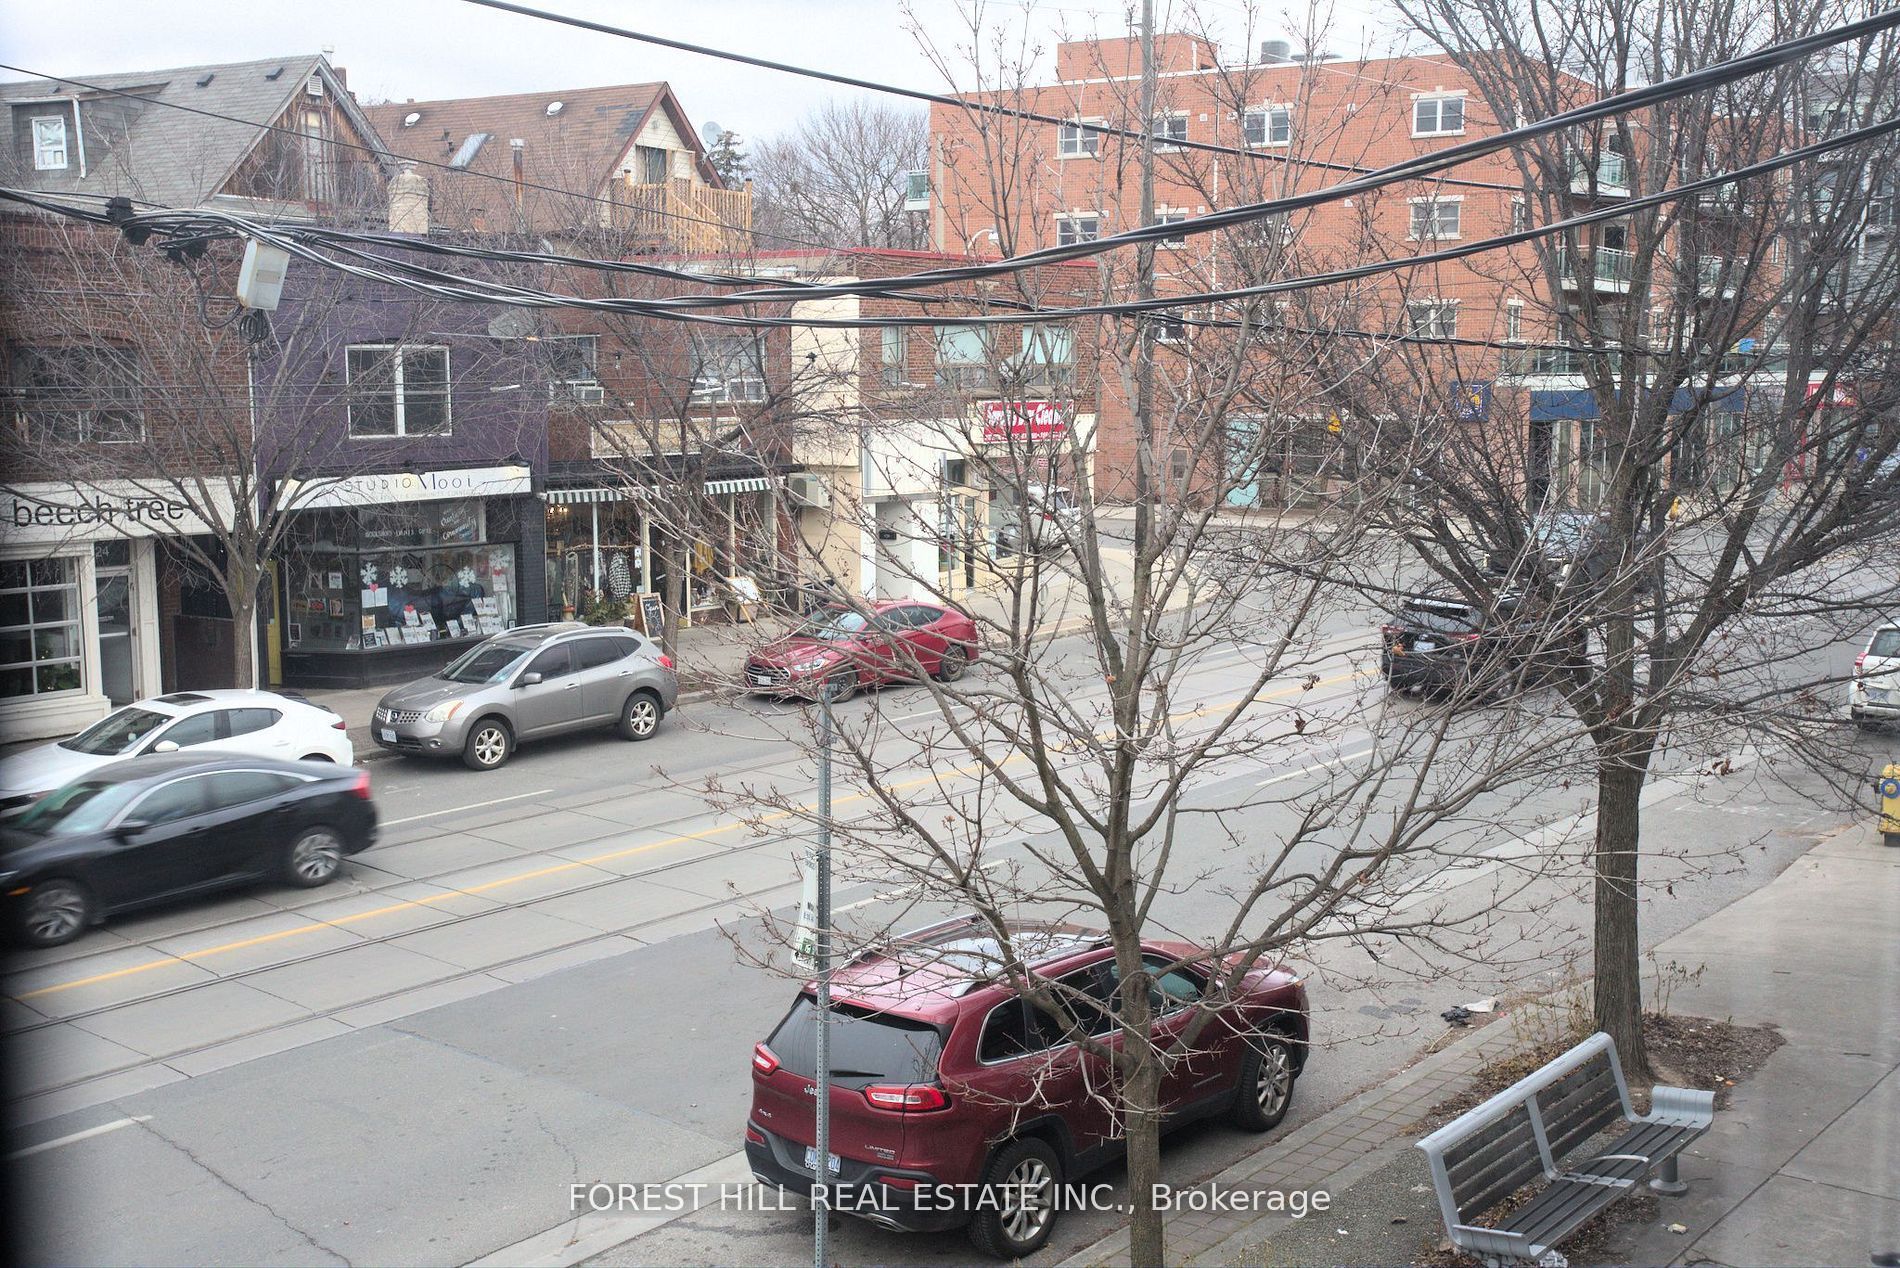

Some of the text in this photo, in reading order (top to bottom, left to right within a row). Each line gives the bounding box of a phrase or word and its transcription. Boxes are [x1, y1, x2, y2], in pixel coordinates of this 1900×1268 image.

[344, 477, 412, 492] STUDIO
[13, 496, 184, 527] beech tree
